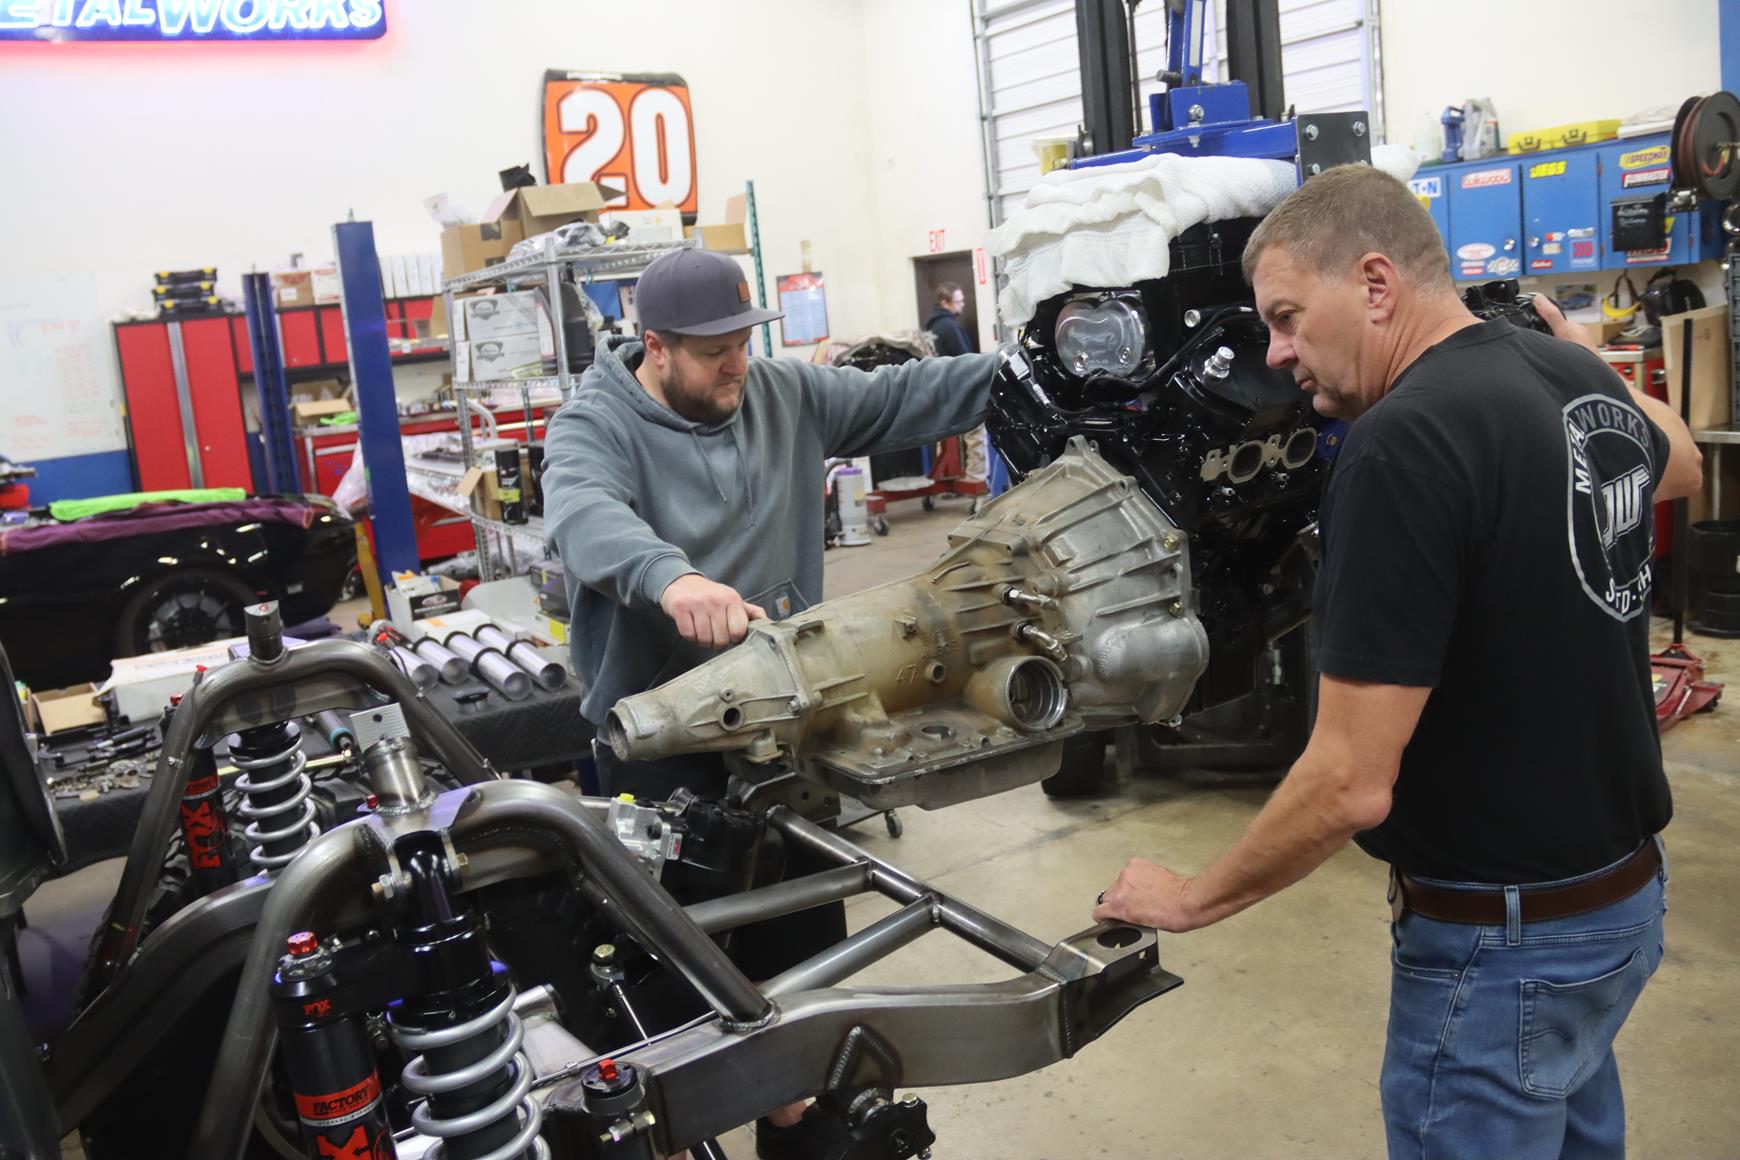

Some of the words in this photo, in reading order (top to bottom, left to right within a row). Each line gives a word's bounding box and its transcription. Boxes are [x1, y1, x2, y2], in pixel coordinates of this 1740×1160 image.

[557, 86, 693, 209] 20
[928, 229, 946, 253] EXIT
[1574, 402, 1651, 448] WORKS
[313, 1086, 368, 1116] FACTORY
